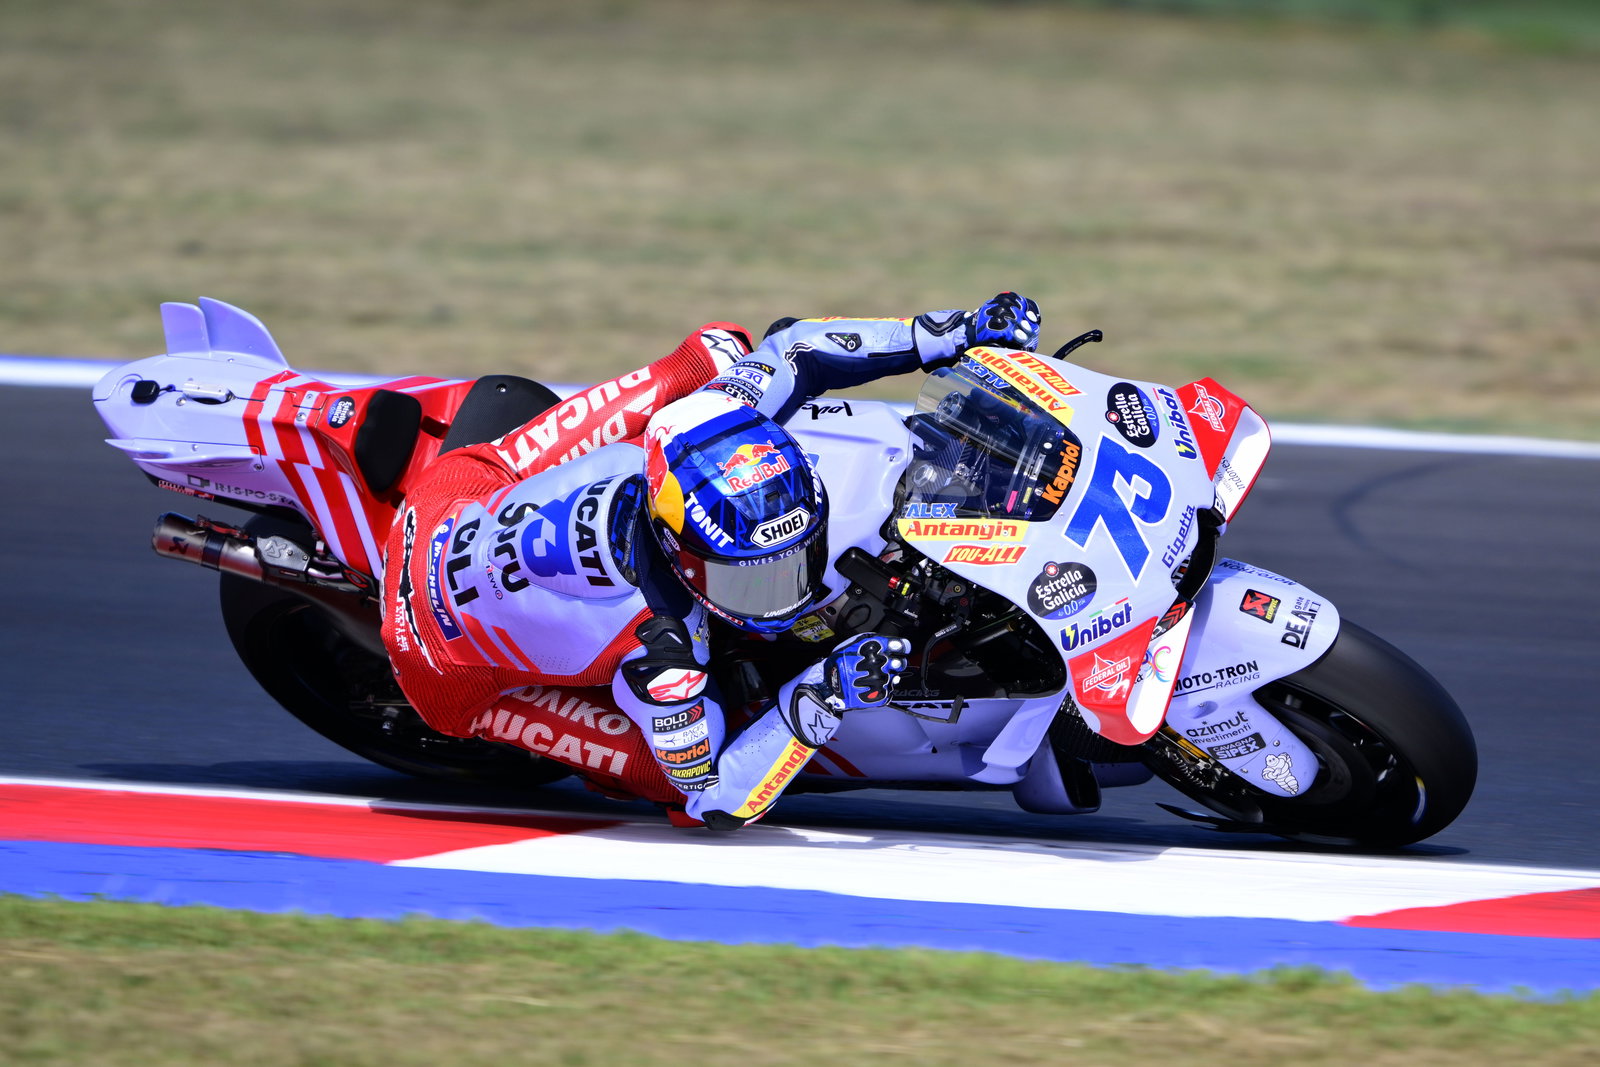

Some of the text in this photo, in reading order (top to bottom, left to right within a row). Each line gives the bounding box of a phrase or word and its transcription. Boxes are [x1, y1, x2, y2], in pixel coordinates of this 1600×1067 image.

[964, 358, 1012, 389] ALEX
[972, 348, 1067, 412] Antangin
[1010, 352, 1074, 394] YOU-ALL
[1115, 393, 1139, 437] Estrella
[1128, 393, 1150, 436] Galicia
[1158, 388, 1197, 459] Unibat
[727, 455, 790, 492] Red Bull
[1042, 440, 1081, 504] Kapriol
[684, 491, 735, 548] TONIT
[905, 503, 958, 519] ALEX
[1062, 433, 1174, 587] 73
[575, 477, 615, 587] UCATI
[761, 514, 804, 543] SHOEI
[905, 520, 1018, 540] Antangin
[1161, 504, 1196, 568] Gigetta
[739, 556, 774, 567] GIVES
[779, 546, 801, 560] YOU
[948, 545, 1020, 562] YOU-ALL
[1035, 569, 1083, 600] Estrella
[1043, 583, 1087, 610] Galicia
[1060, 603, 1132, 651] Unibat
[1085, 668, 1116, 688] FEDERAL
[1115, 661, 1128, 674] OIL
[1216, 673, 1260, 689] RACING
[655, 712, 687, 727] BOLD
[1186, 711, 1248, 737] azimut
[1191, 724, 1251, 744] investimenti
[468, 709, 628, 776] DUCATI
[656, 739, 709, 763] Kapriol
[1212, 737, 1255, 751] CAVAGNA
[1216, 742, 1260, 759] SIPEX
[747, 741, 808, 813] Antangi
